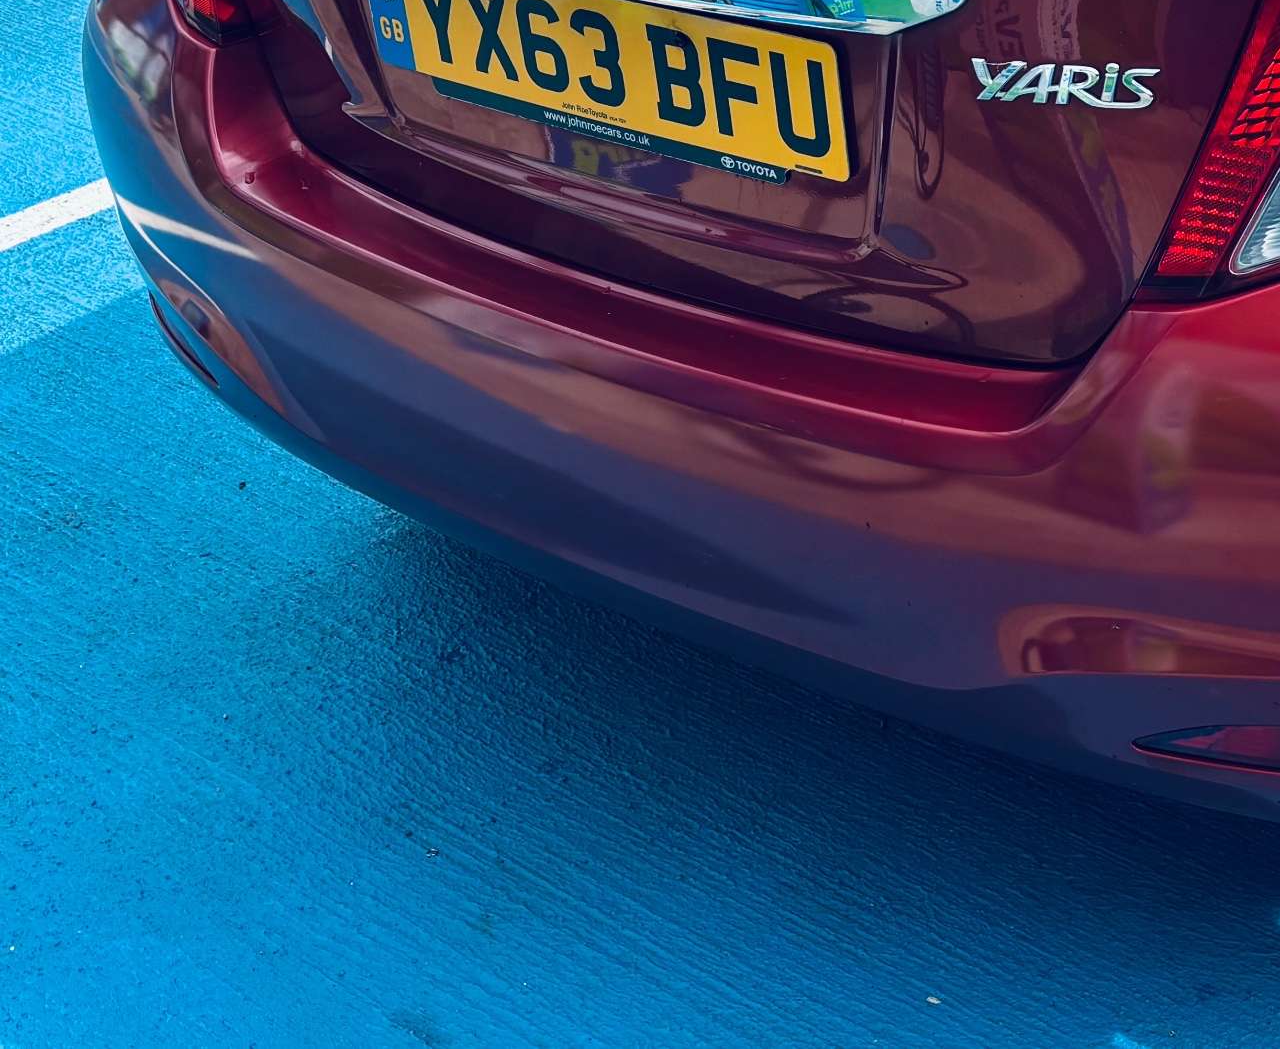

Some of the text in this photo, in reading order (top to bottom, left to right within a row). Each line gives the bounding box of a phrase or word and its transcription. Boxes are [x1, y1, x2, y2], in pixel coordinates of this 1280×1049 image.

[379, 15, 405, 43] GB
[645, 23, 833, 159] BFU
[561, 101, 576, 111] John
[543, 110, 651, 147] www.johnroecars.co.uk
[735, 160, 778, 180] TOYOTA
